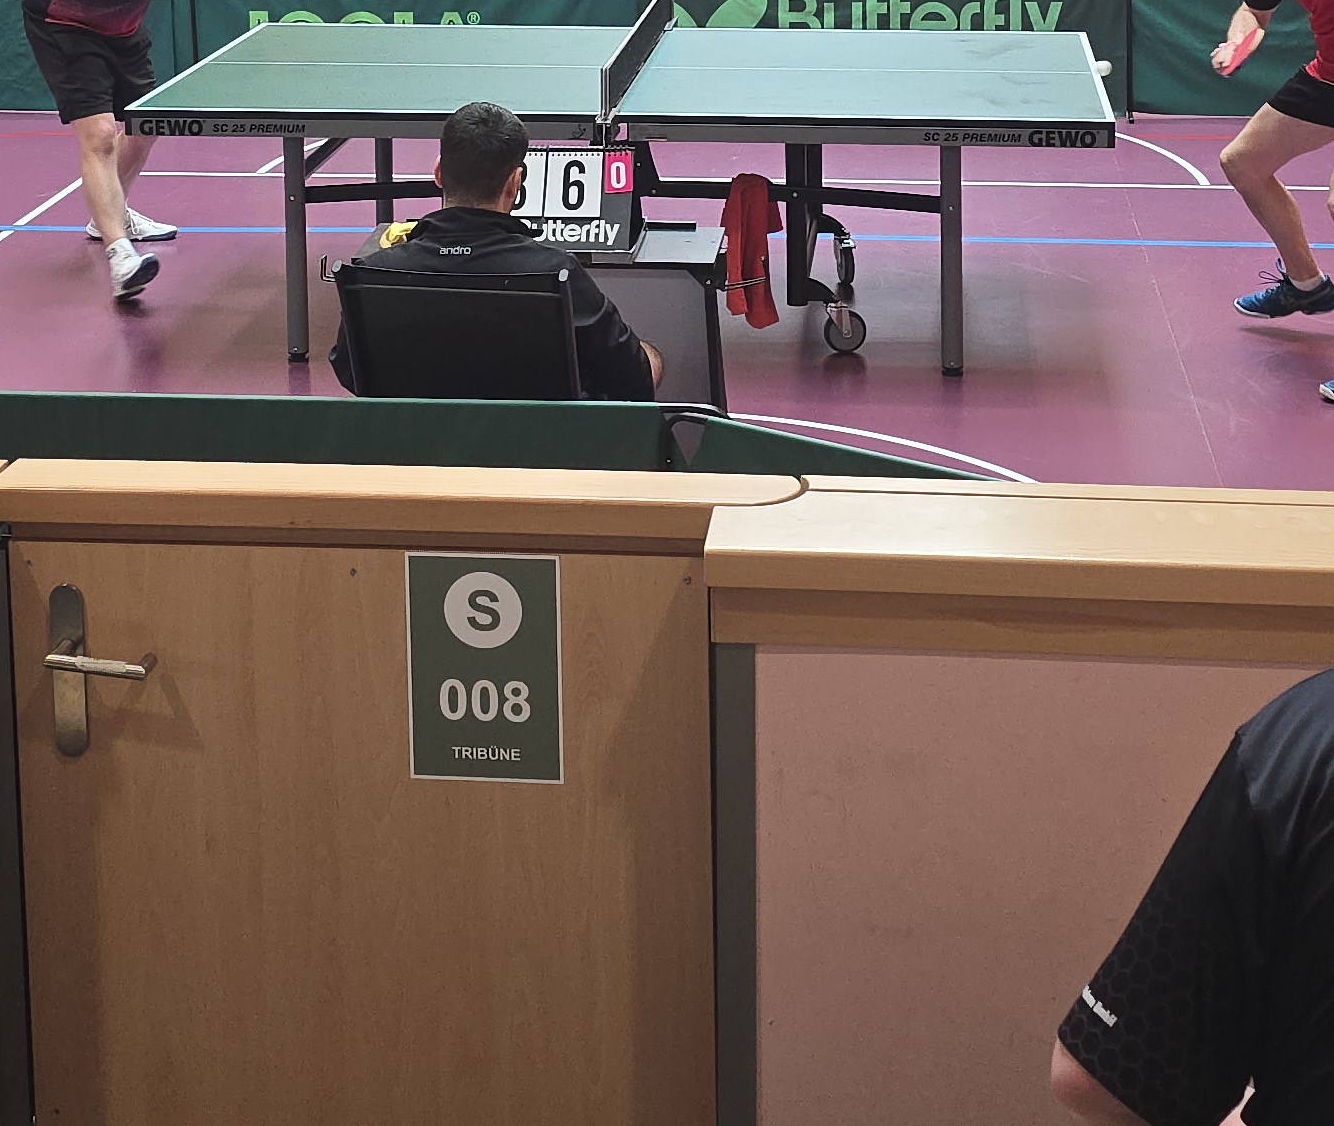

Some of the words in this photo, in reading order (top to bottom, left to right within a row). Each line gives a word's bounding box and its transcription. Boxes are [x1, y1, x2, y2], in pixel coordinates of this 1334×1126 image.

[139, 119, 204, 136] GEWO
[212, 123, 229, 133] SC
[231, 123, 246, 133] 25
[248, 123, 306, 134] PREMIUM
[923, 132, 941, 142] SC
[943, 132, 959, 142] 25
[961, 132, 1022, 143] PREMIUM
[1028, 130, 1097, 148] GEWO
[562, 159, 586, 211] 6
[610, 161, 627, 189] 0
[439, 245, 472, 255] andro
[466, 589, 501, 632] S
[439, 678, 531, 723] 008
[452, 745, 521, 762] TRIBÜNE
